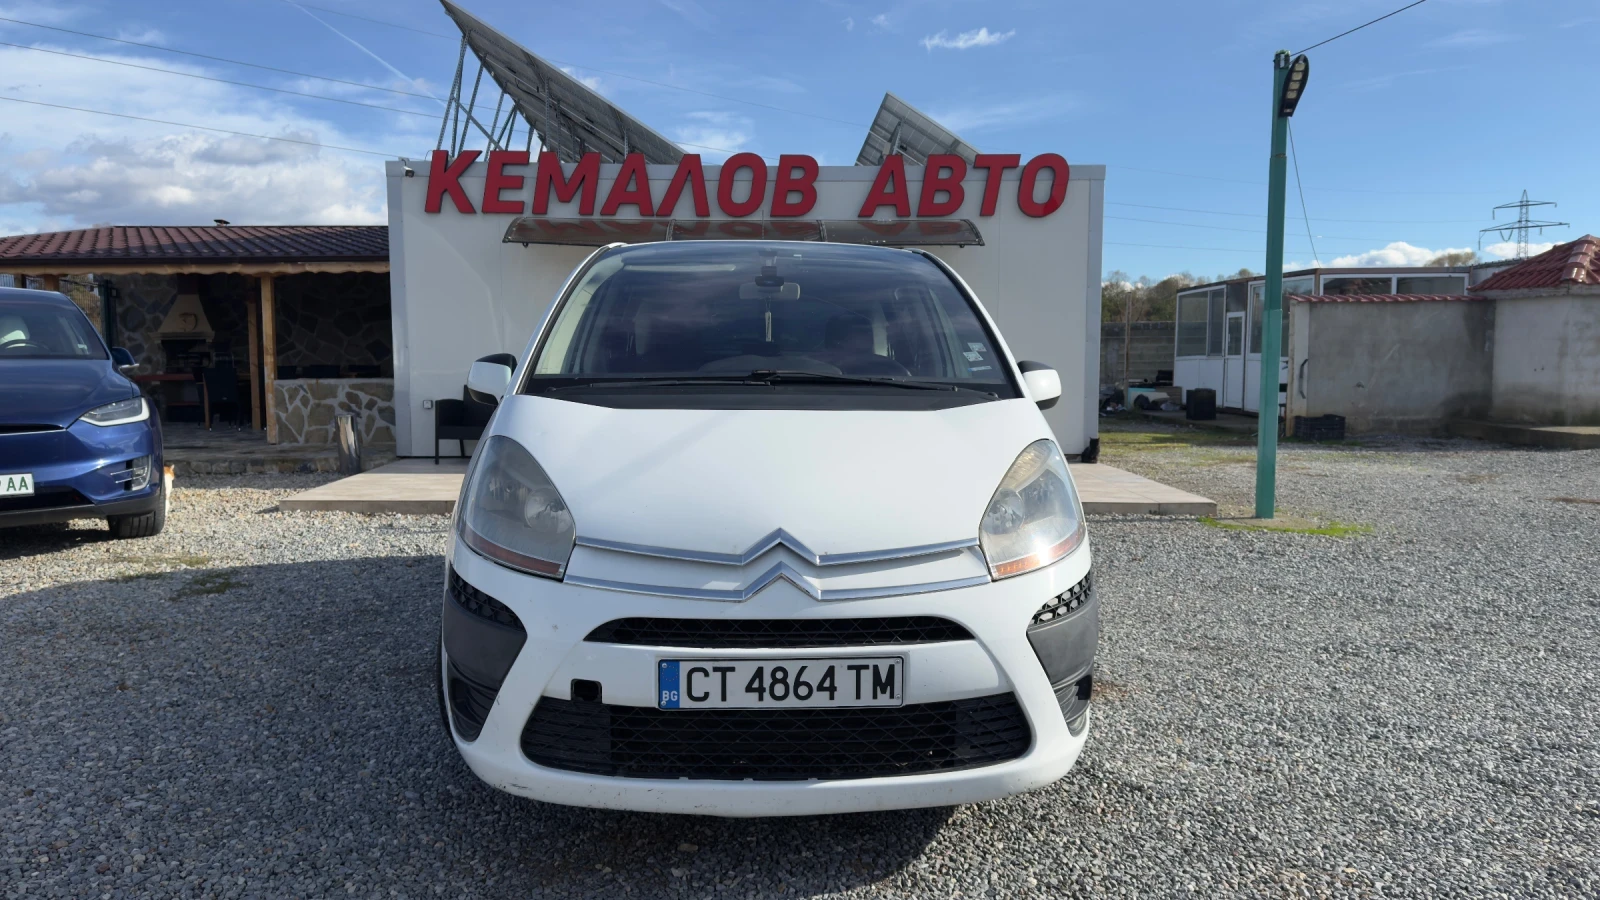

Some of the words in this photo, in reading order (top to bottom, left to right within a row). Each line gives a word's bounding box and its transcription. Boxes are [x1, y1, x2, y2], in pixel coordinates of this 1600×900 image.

[424, 150, 820, 218] КЕМАЛОВ
[858, 153, 1070, 218] АВТО
[6, 476, 29, 492] AA
[662, 690, 678, 702] BG
[686, 666, 736, 702] CT
[744, 665, 838, 701] 4864
[847, 664, 896, 700] TM
